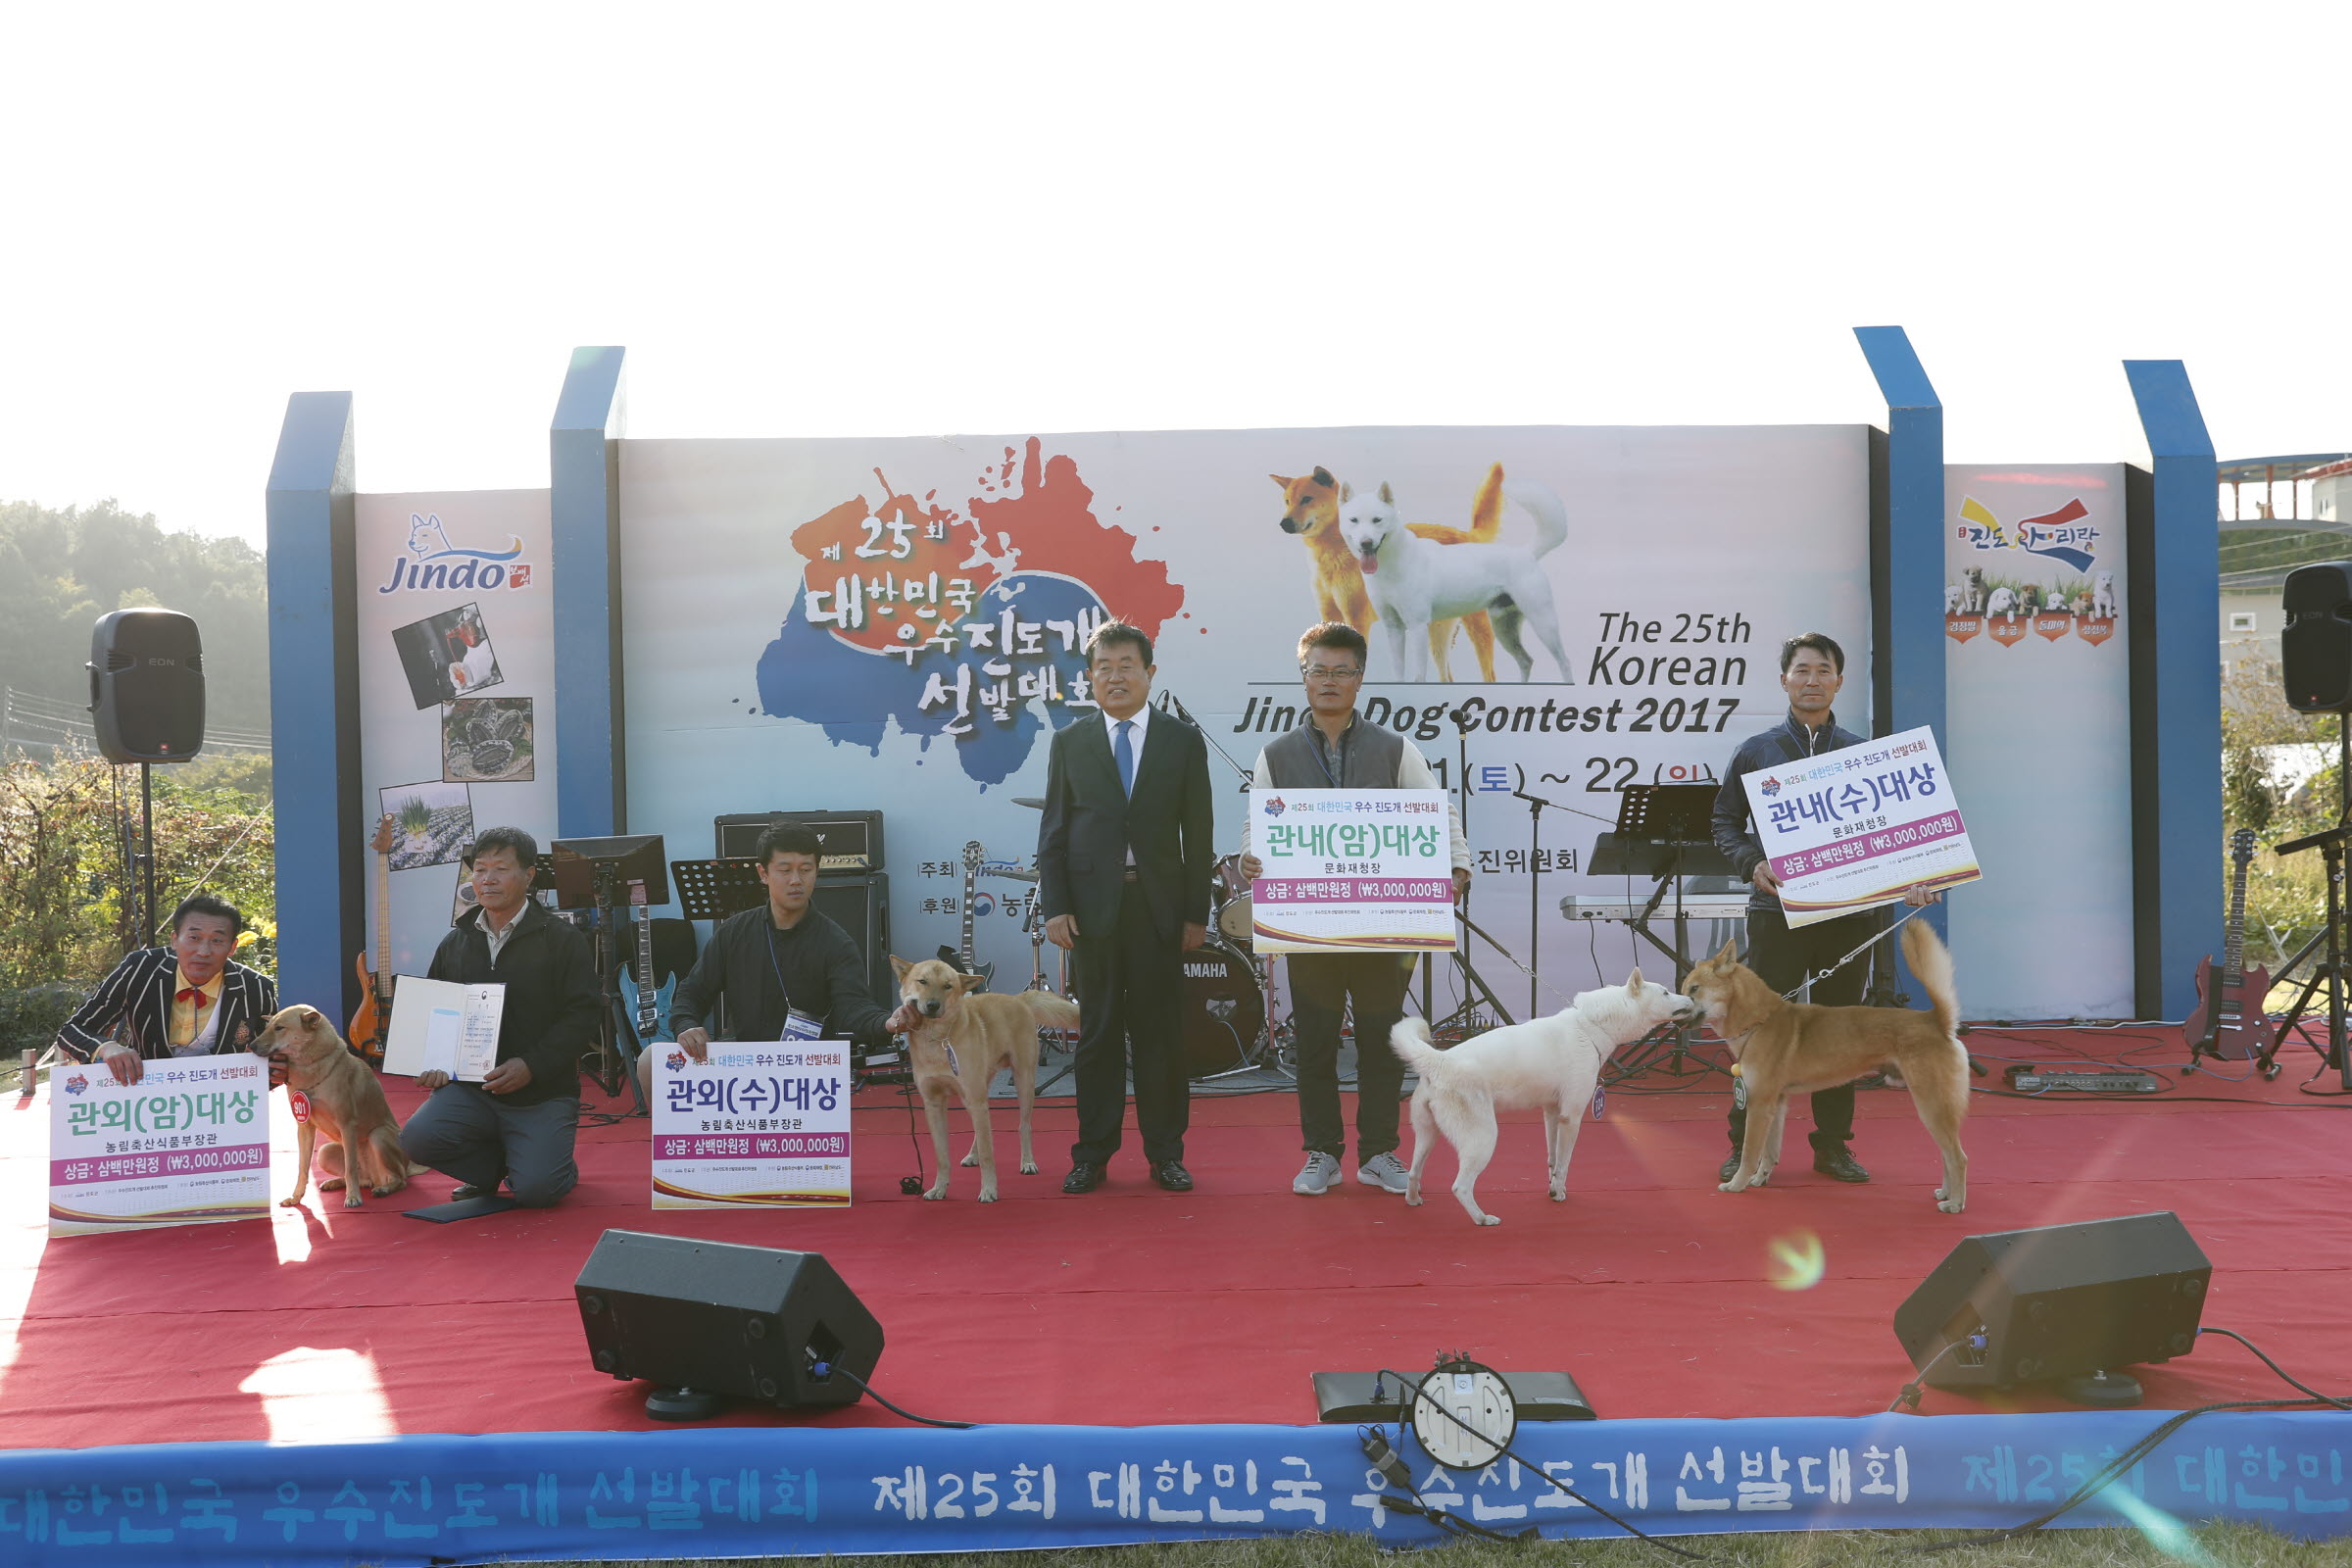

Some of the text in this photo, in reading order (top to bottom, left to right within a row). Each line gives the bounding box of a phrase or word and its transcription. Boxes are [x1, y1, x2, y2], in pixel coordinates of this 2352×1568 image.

[379, 558, 506, 594] Jindo
[804, 571, 977, 628] 대한민국
[1599, 612, 1751, 644] The 25th
[148, 658, 175, 666] EON
[1588, 646, 1746, 686] Korean
[1233, 696, 1740, 741] Jin Dog Contest 2017
[1808, 762, 1844, 780] 대한민국
[1844, 755, 1862, 771] 우수
[1863, 750, 1890, 766] 진도개
[1891, 739, 1928, 760] 선발대회
[1585, 757, 1639, 793] 22
[1291, 801, 1439, 813] 제25회 대한민국 우수 진도개 선발대회
[1767, 762, 1936, 833] 관내(수)대상
[1266, 822, 1441, 859] 관내(암)대상
[1833, 815, 1887, 838] 문화재청장
[1324, 862, 1382, 874] 문화재청장
[1470, 849, 1578, 874] 진위원회
[1783, 857, 1810, 875] 상금:
[1810, 841, 1866, 869] 삼백만원정
[1265, 882, 1292, 899] 상금:
[1295, 881, 1351, 899] 삼백만원정
[1183, 962, 1228, 978] AMAHA
[167, 1071, 186, 1083] 우수
[188, 1069, 218, 1082] 진도개
[220, 1065, 258, 1080] 선발대회
[718, 1054, 754, 1067] 대한민국
[756, 1054, 774, 1066] 우수
[776, 1054, 803, 1066] 진도개
[805, 1053, 841, 1066] 선발대회
[294, 1102, 307, 1114] 901
[666, 1077, 841, 1114] 관외(수)대상
[68, 1089, 260, 1137] 관외(암)대상
[701, 1118, 803, 1131] 농림축산식품부장관
[105, 1133, 218, 1153] 농림축산식품부장관
[664, 1139, 691, 1155] 상금:
[694, 1138, 750, 1154] 삼백만원정
[64, 1162, 94, 1180] 상금:
[97, 1155, 160, 1177] 삼백만원정
[871, 1462, 1055, 1522] 제25회
[1088, 1454, 1327, 1525] 대한민국
[1675, 1445, 1909, 1512] 선발대회
[0, 1477, 239, 1545] 대한민국
[588, 1465, 818, 1531] 선발대회
